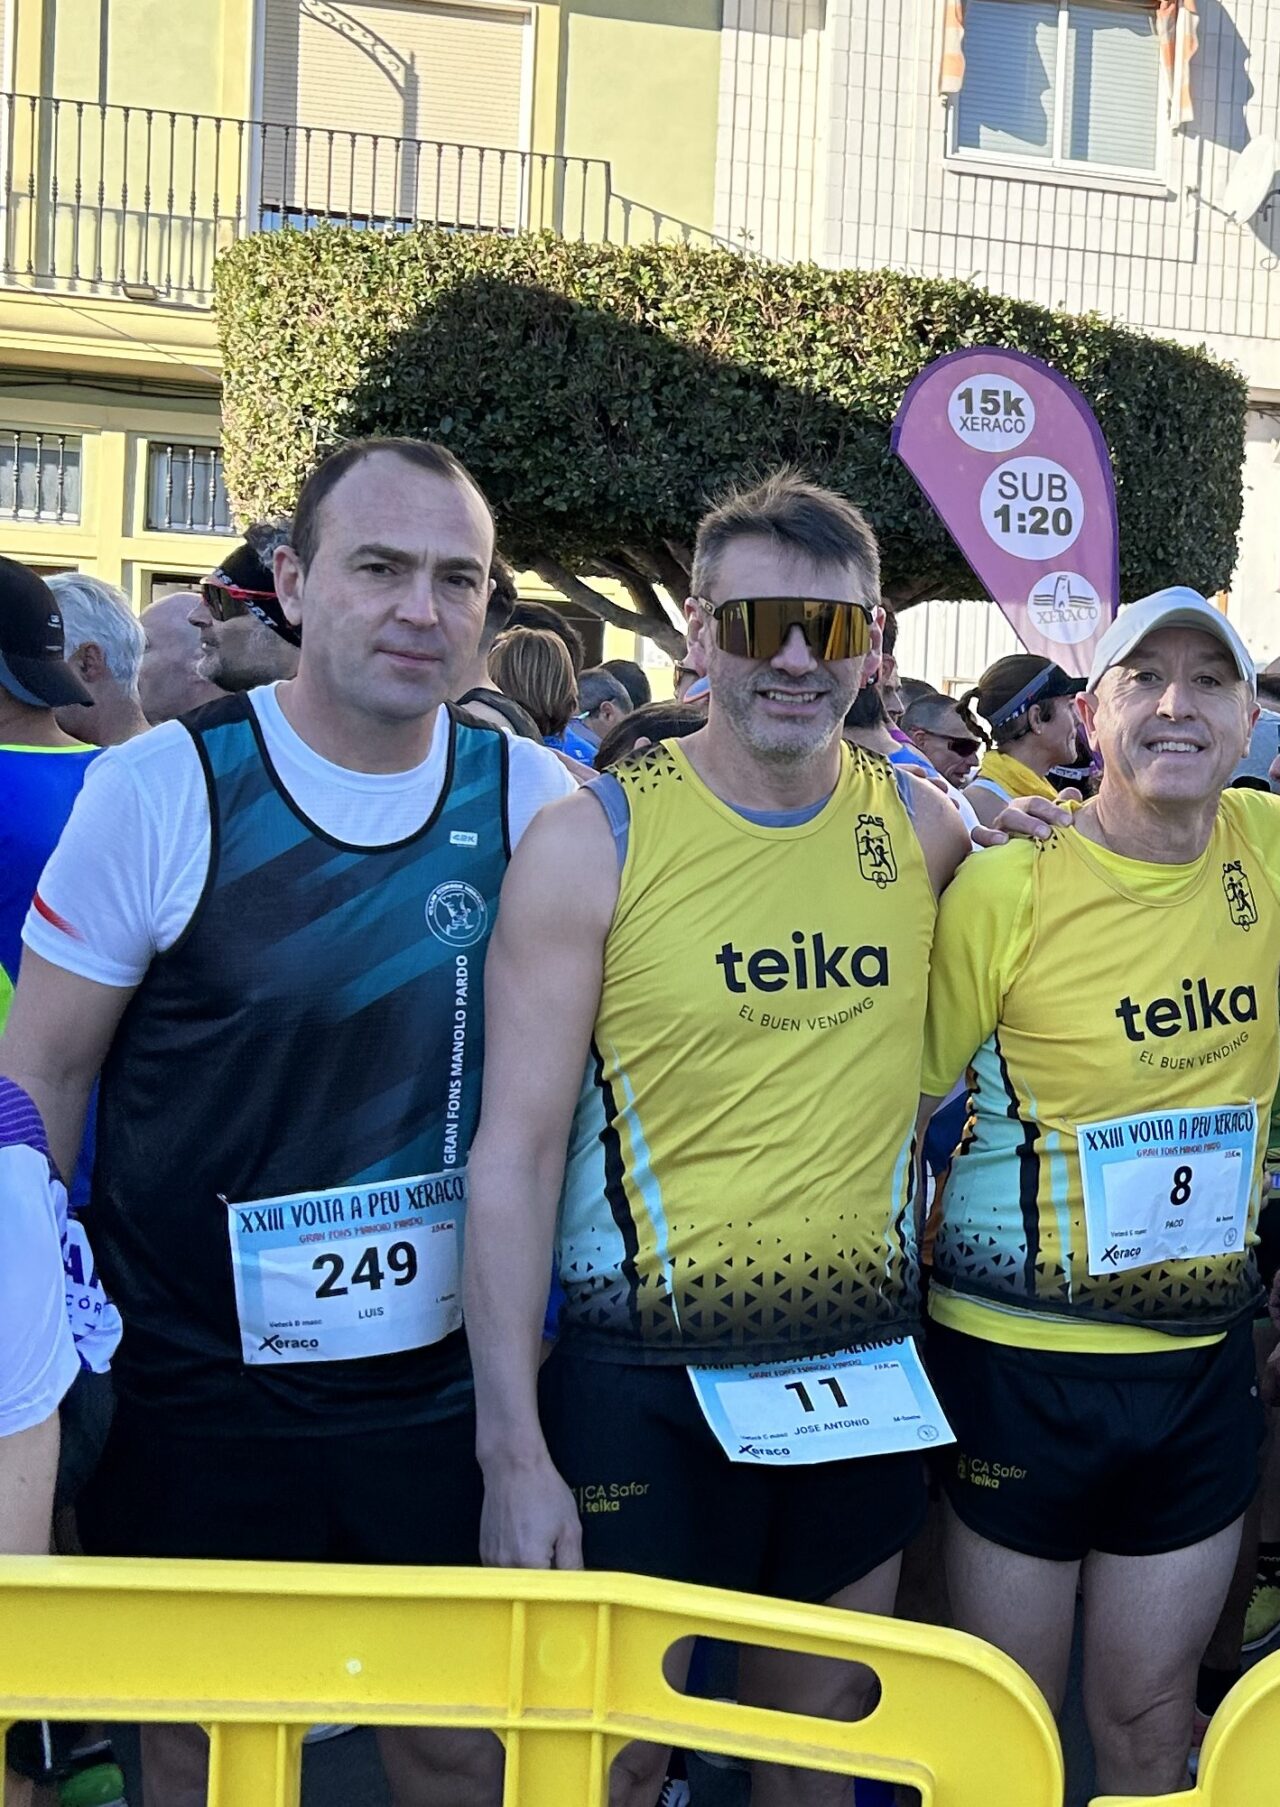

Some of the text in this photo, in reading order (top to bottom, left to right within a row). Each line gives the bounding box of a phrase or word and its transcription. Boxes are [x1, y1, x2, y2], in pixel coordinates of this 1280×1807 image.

[958, 387, 1025, 417] 15k
[959, 416, 1025, 434] XERACO
[998, 471, 1068, 502] SUB
[993, 504, 1073, 537] 1:20
[1036, 606, 1098, 625] XERACO
[858, 814, 884, 827] CAS
[715, 931, 889, 993] teika
[738, 997, 874, 1031] EL BUEN VENDING
[1115, 977, 1258, 1042] teika
[443, 954, 469, 1165] GRAN FONS MANOLO PARDO
[1139, 1031, 1249, 1070] EL BUEN VENDING
[1086, 1110, 1254, 1152] XXIII VOLTA A PEU XERACO
[1170, 1165, 1194, 1206] 8
[240, 1176, 465, 1233] XXIII VOLTA A PEU XERACO
[1165, 1218, 1184, 1229] PACO
[1100, 1244, 1142, 1266] Xeraco
[312, 1241, 418, 1299] 249
[358, 1307, 385, 1320] LUIS
[258, 1334, 319, 1356] Xeraco
[784, 1376, 848, 1413] 11
[794, 1425, 822, 1436] JOSE
[824, 1417, 870, 1432] ANTONIO
[738, 1444, 791, 1459] Xeraco
[970, 1472, 1000, 1489] teika
[971, 1458, 1028, 1480] CA Safor
[584, 1482, 650, 1499] CA Safor
[585, 1499, 620, 1512] teika
